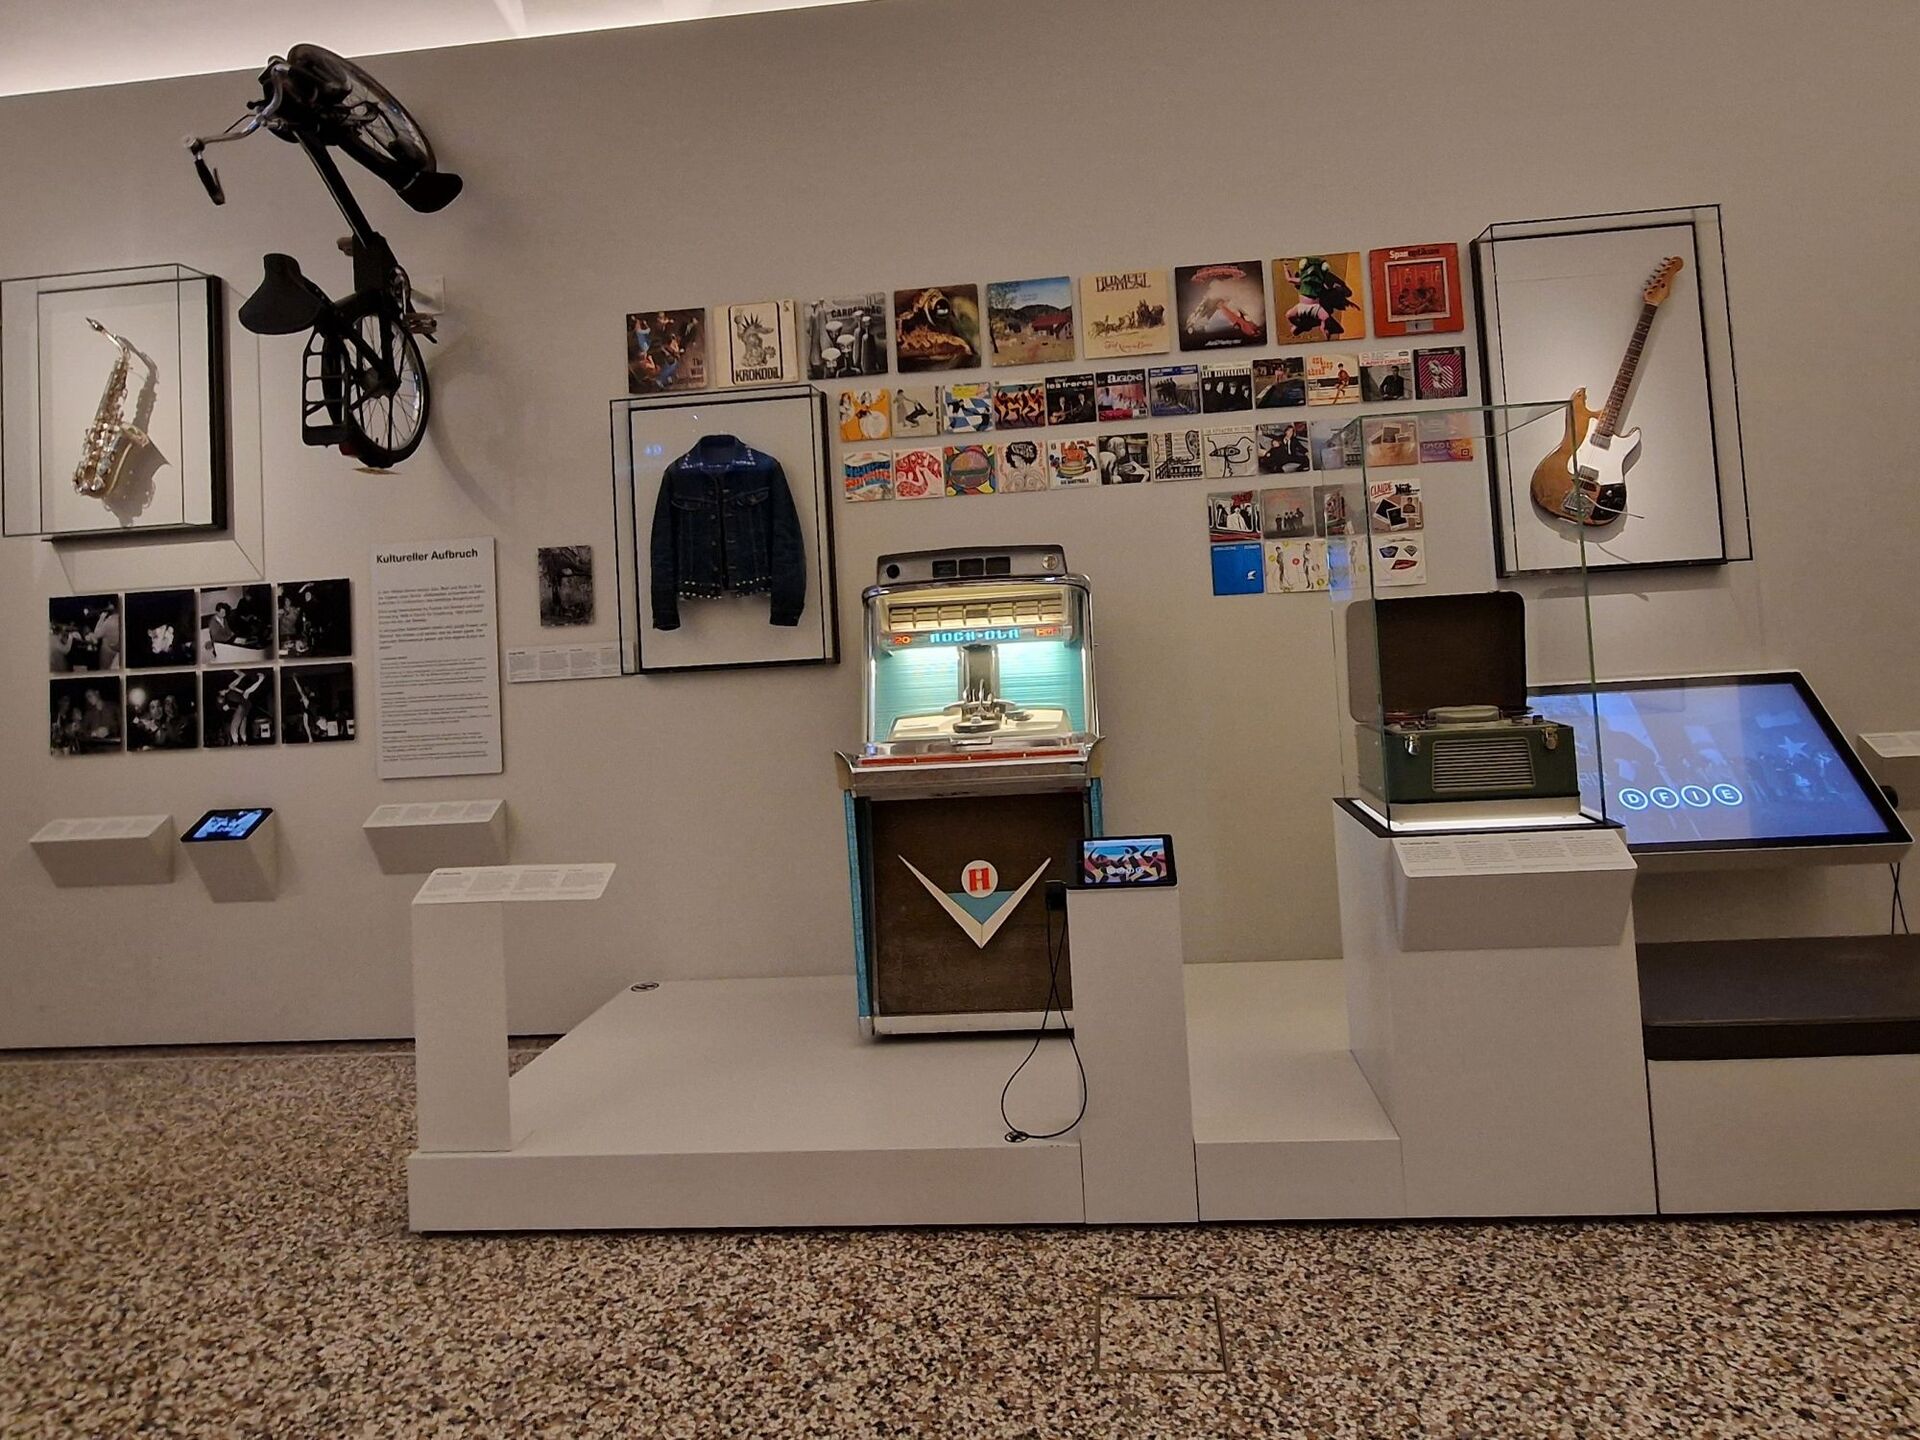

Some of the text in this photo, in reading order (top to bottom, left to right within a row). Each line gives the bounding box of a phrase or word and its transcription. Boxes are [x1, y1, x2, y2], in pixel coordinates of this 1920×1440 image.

[735, 366, 779, 382] KROKODIL
[376, 548, 478, 564] Kultureller Aufbruch
[969, 867, 991, 892] H
